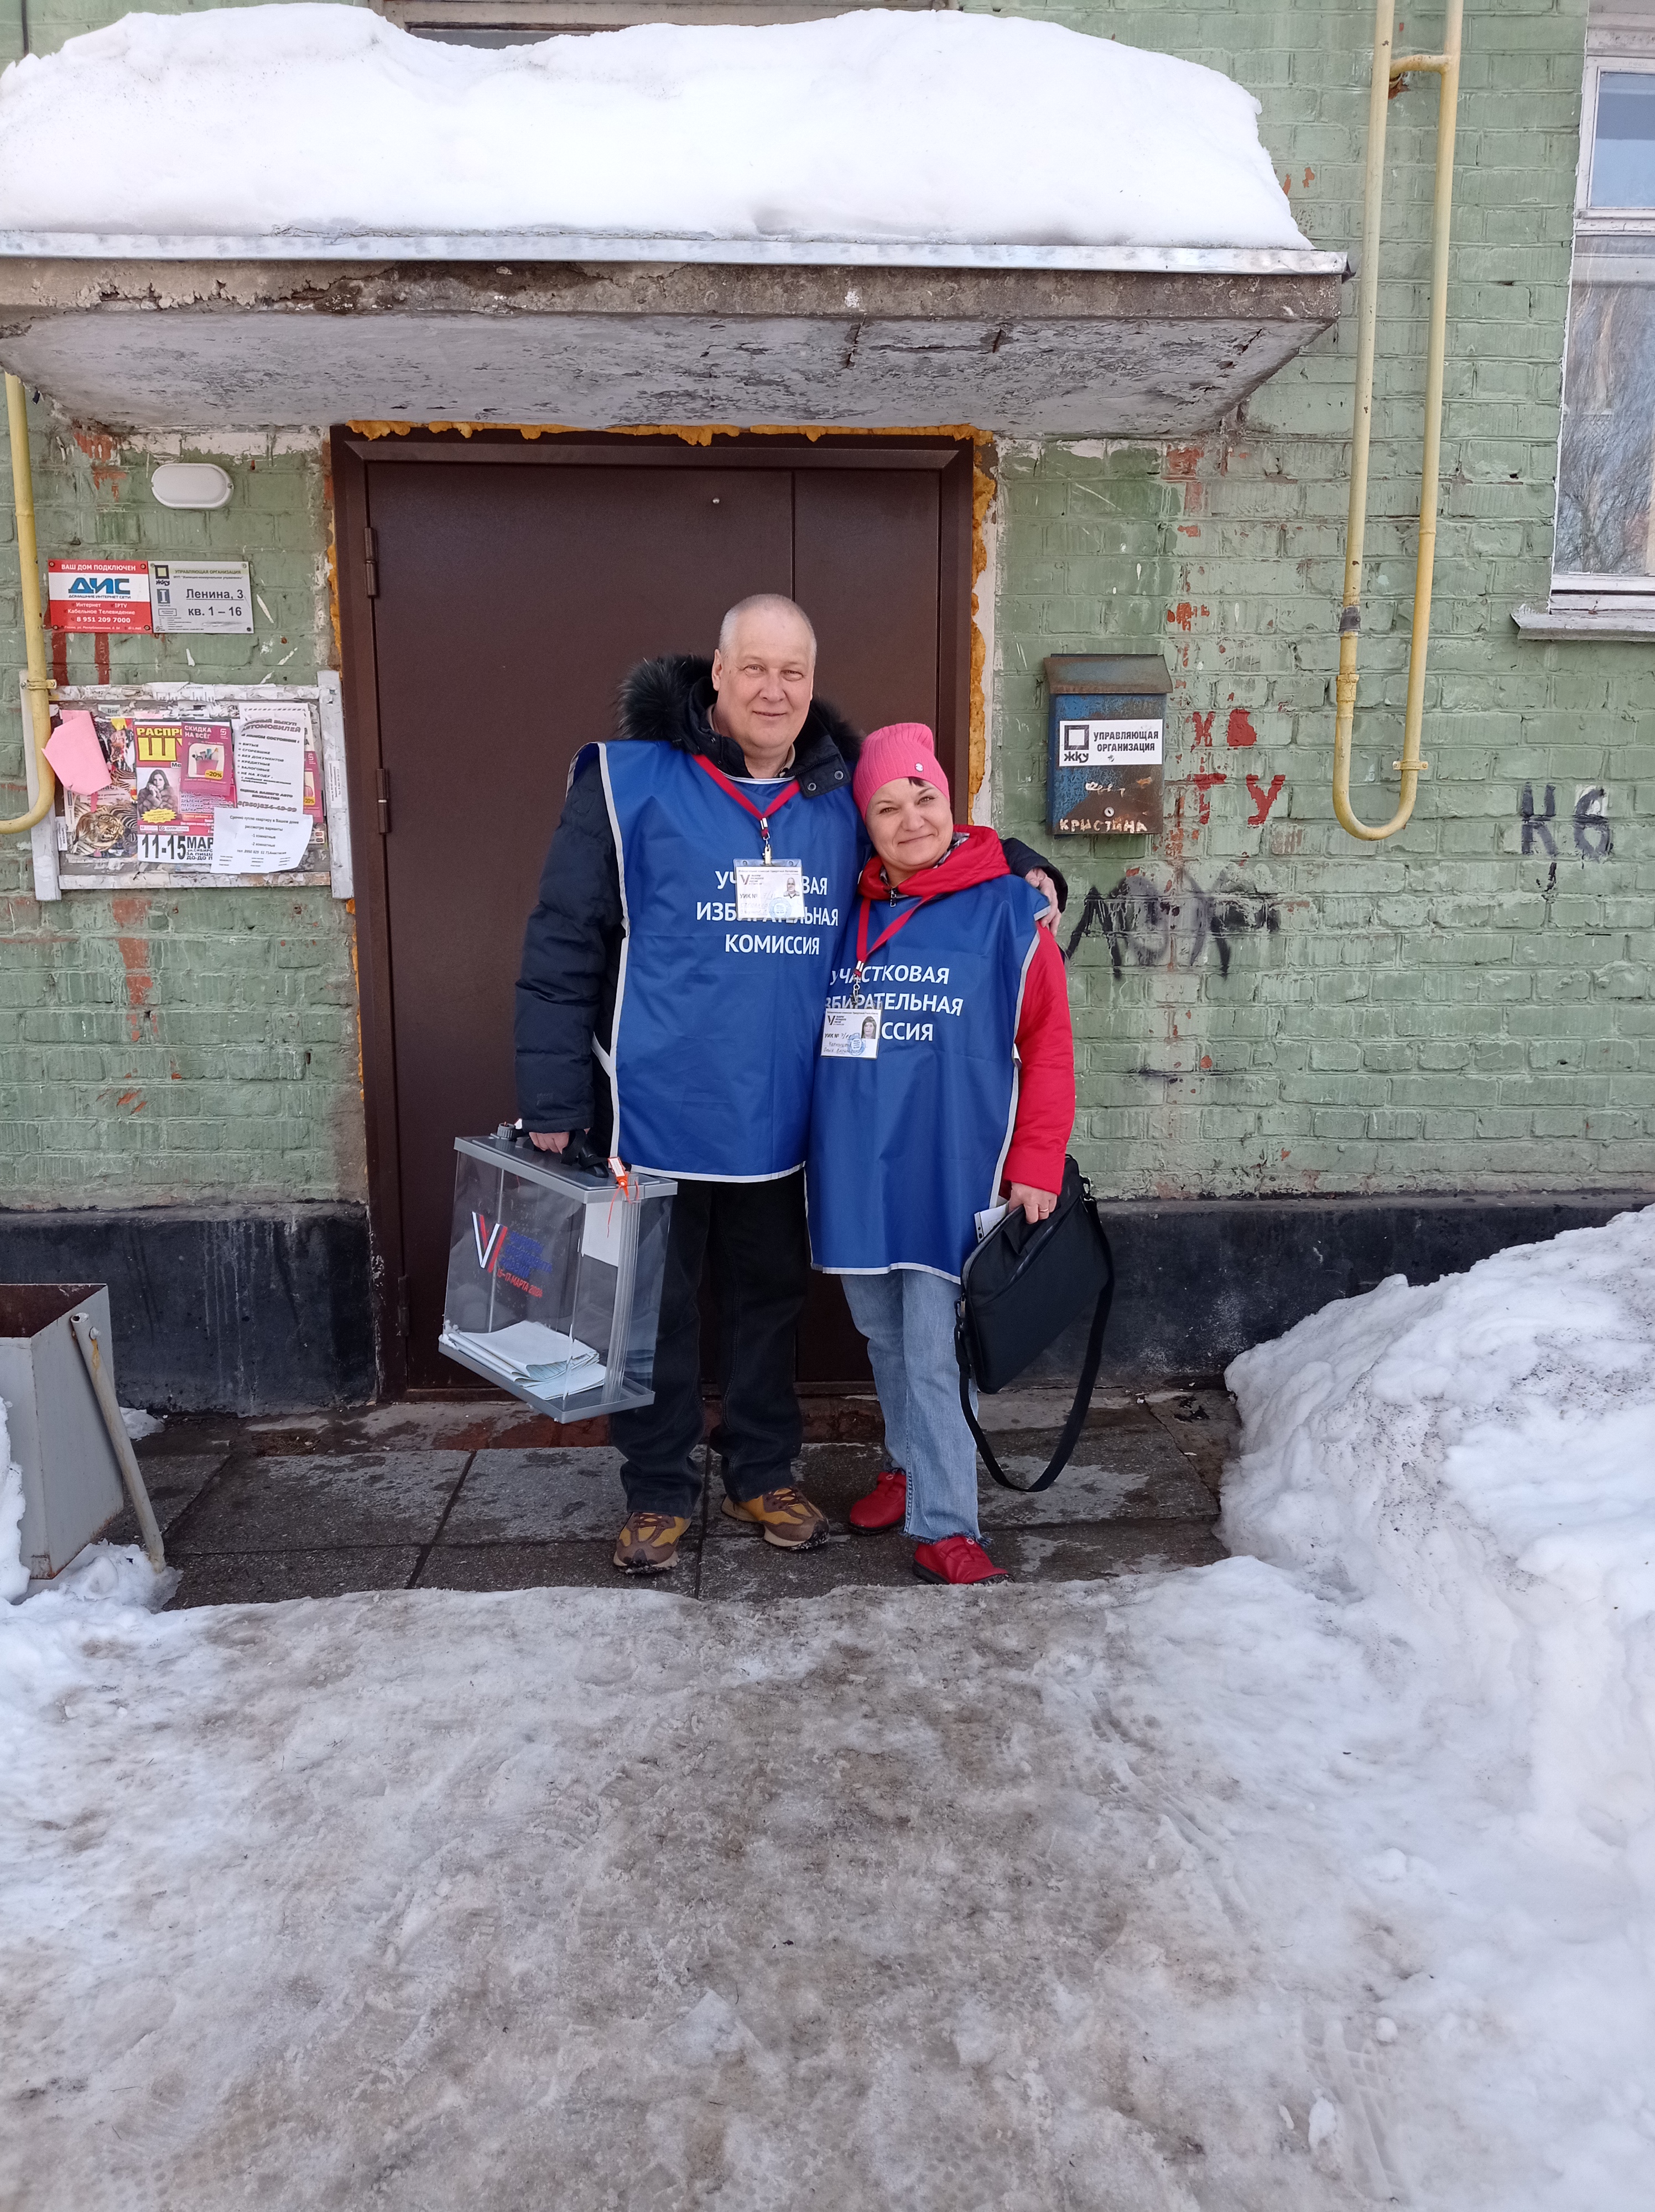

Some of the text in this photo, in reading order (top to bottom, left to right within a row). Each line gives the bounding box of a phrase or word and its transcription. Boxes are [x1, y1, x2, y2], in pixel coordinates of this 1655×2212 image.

[68, 577, 131, 594] ДИС
[186, 589, 243, 599] Ленина, 3
[208, 606, 214, 616] 1
[228, 607, 242, 616] 16
[137, 727, 183, 737] РАСПР
[1093, 731, 1159, 742] УПРАВЛЯЮЩАЯ
[1097, 743, 1155, 753] ОРГАНИЗАЦИЯ
[142, 834, 186, 860] 11-15
[715, 871, 828, 895] УЧВАЯ
[696, 902, 838, 926] ИЗБЬНАЯ
[725, 934, 820, 954] КОМИССИЯ
[825, 993, 964, 1016] ЗБИРАТЕЛЬНАЯ
[882, 1022, 933, 1041] ССИЯ
[510, 1275, 529, 1292] МАРТА
